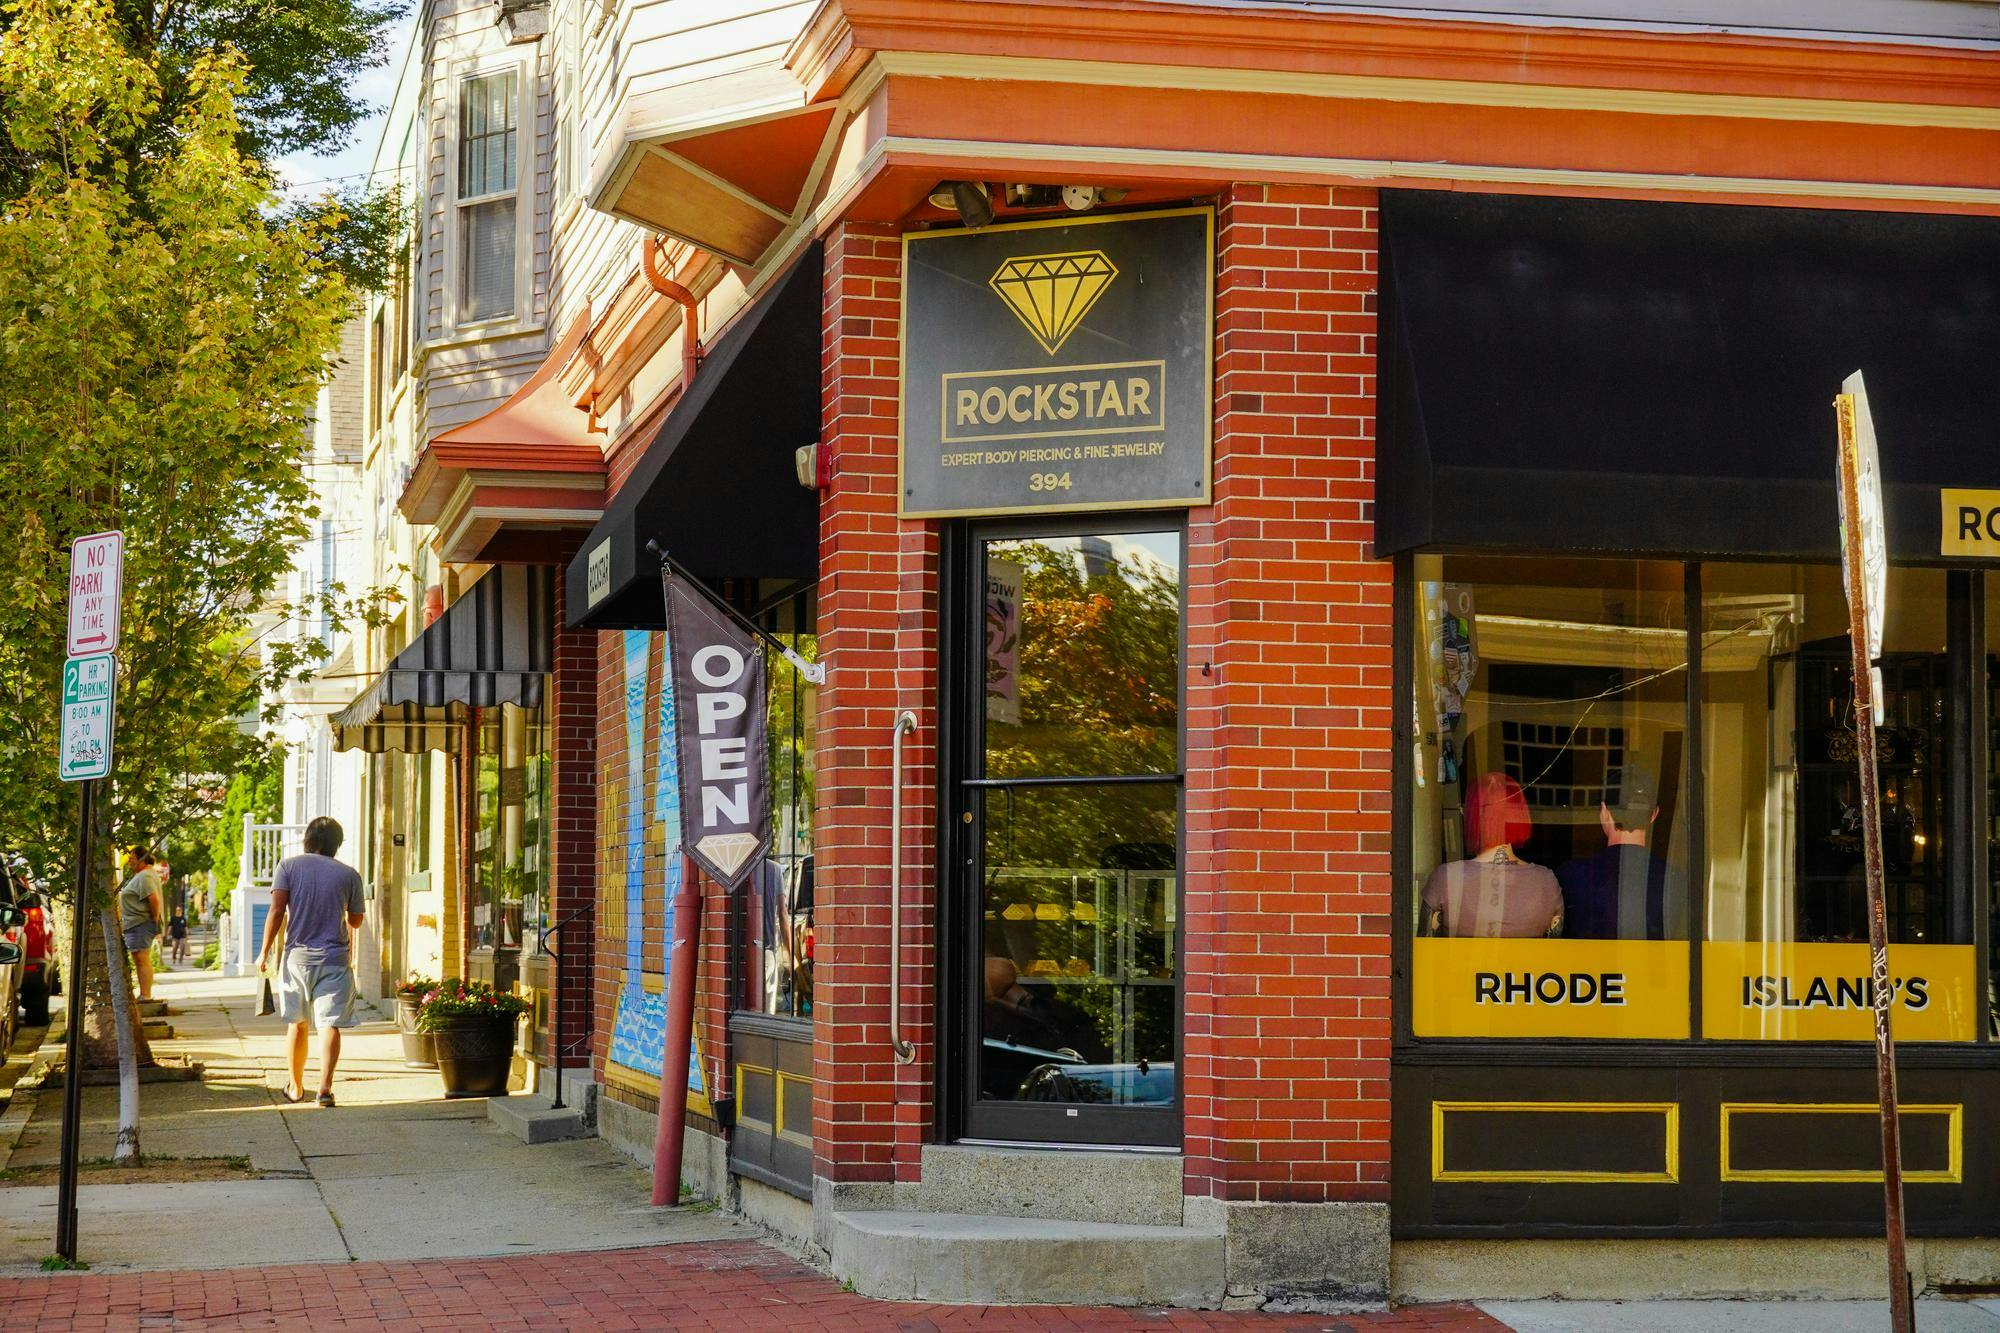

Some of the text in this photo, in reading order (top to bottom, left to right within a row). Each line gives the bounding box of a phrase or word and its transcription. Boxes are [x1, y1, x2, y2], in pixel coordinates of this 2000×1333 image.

[956, 378, 1152, 426] ROCKSTAR
[941, 442, 1165, 467] EXPERT BODY PIERCING & FINE JEWELRY
[1029, 472, 1072, 491] 394
[87, 544, 105, 568] NO
[84, 597, 103, 612] ANY
[82, 613, 104, 630] TIME
[88, 664, 98, 679] HR
[66, 667, 78, 697] 2
[79, 680, 108, 697] PARKING
[72, 705, 101, 719] 8:00 AM
[82, 723, 90, 736] TO
[691, 644, 750, 827] OPEN
[1475, 972, 1627, 1006] RHODE
